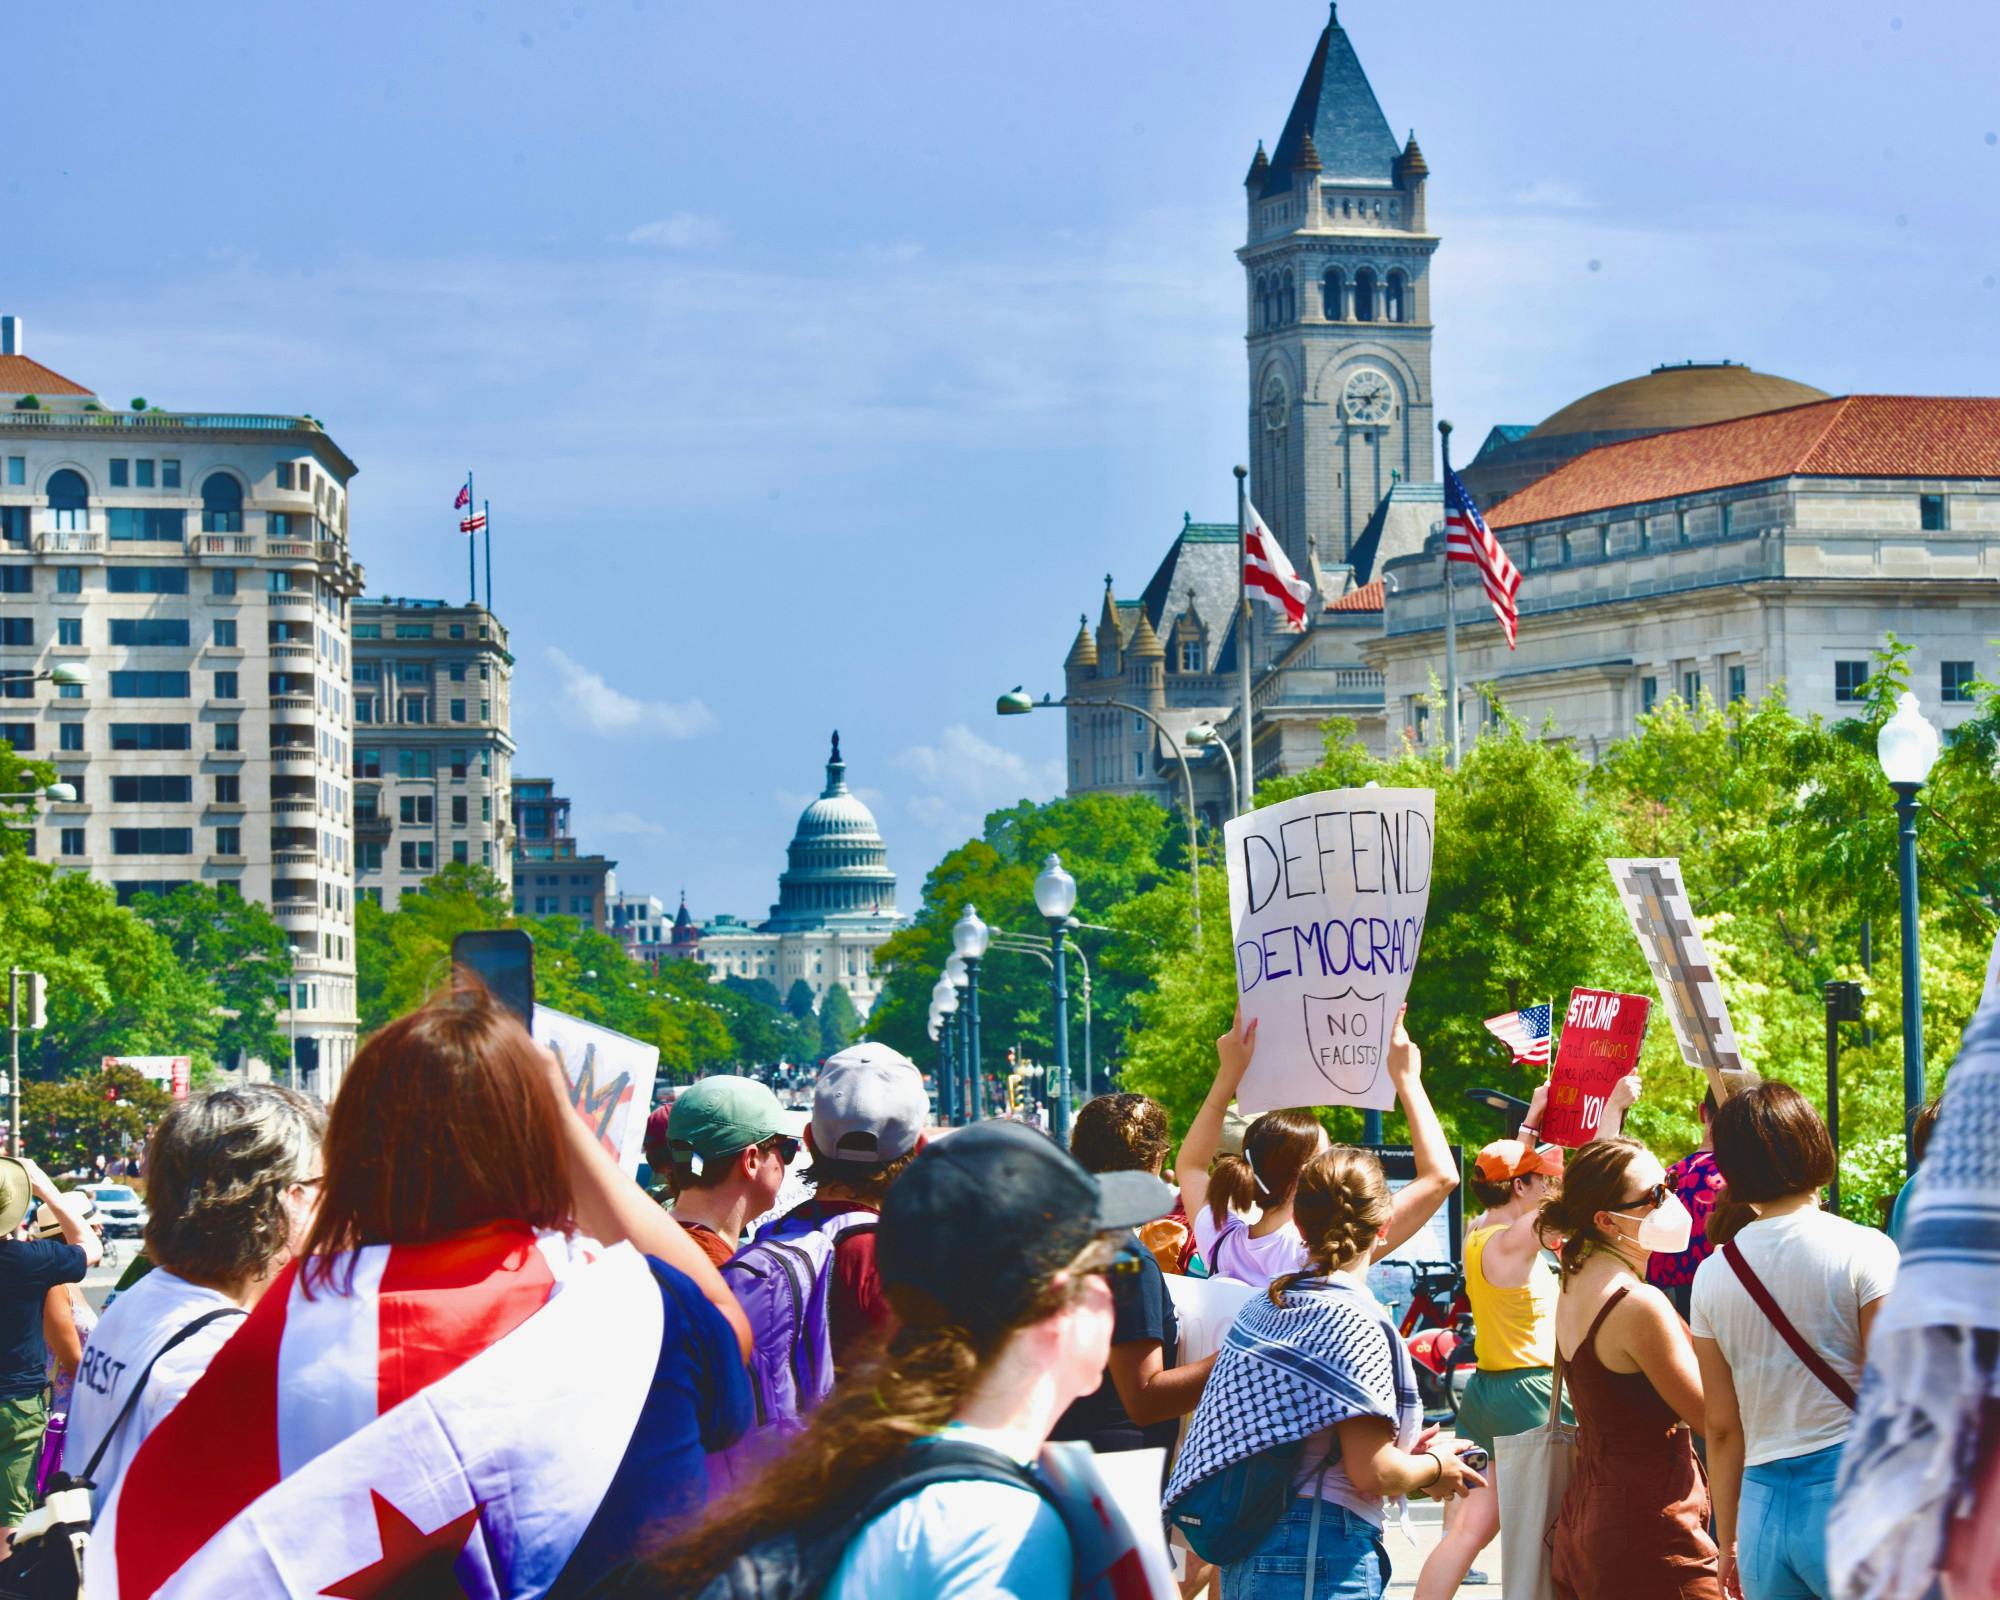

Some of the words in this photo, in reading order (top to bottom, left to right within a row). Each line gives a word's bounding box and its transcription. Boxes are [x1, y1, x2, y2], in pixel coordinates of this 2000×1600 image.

[1244, 810, 1431, 915] DEFEND
[1237, 916, 1424, 993] DEMOCRACY
[1327, 1013, 1368, 1037] NO
[1568, 994, 1620, 1031] $TRUMP
[1320, 1045, 1377, 1066] FACISTS
